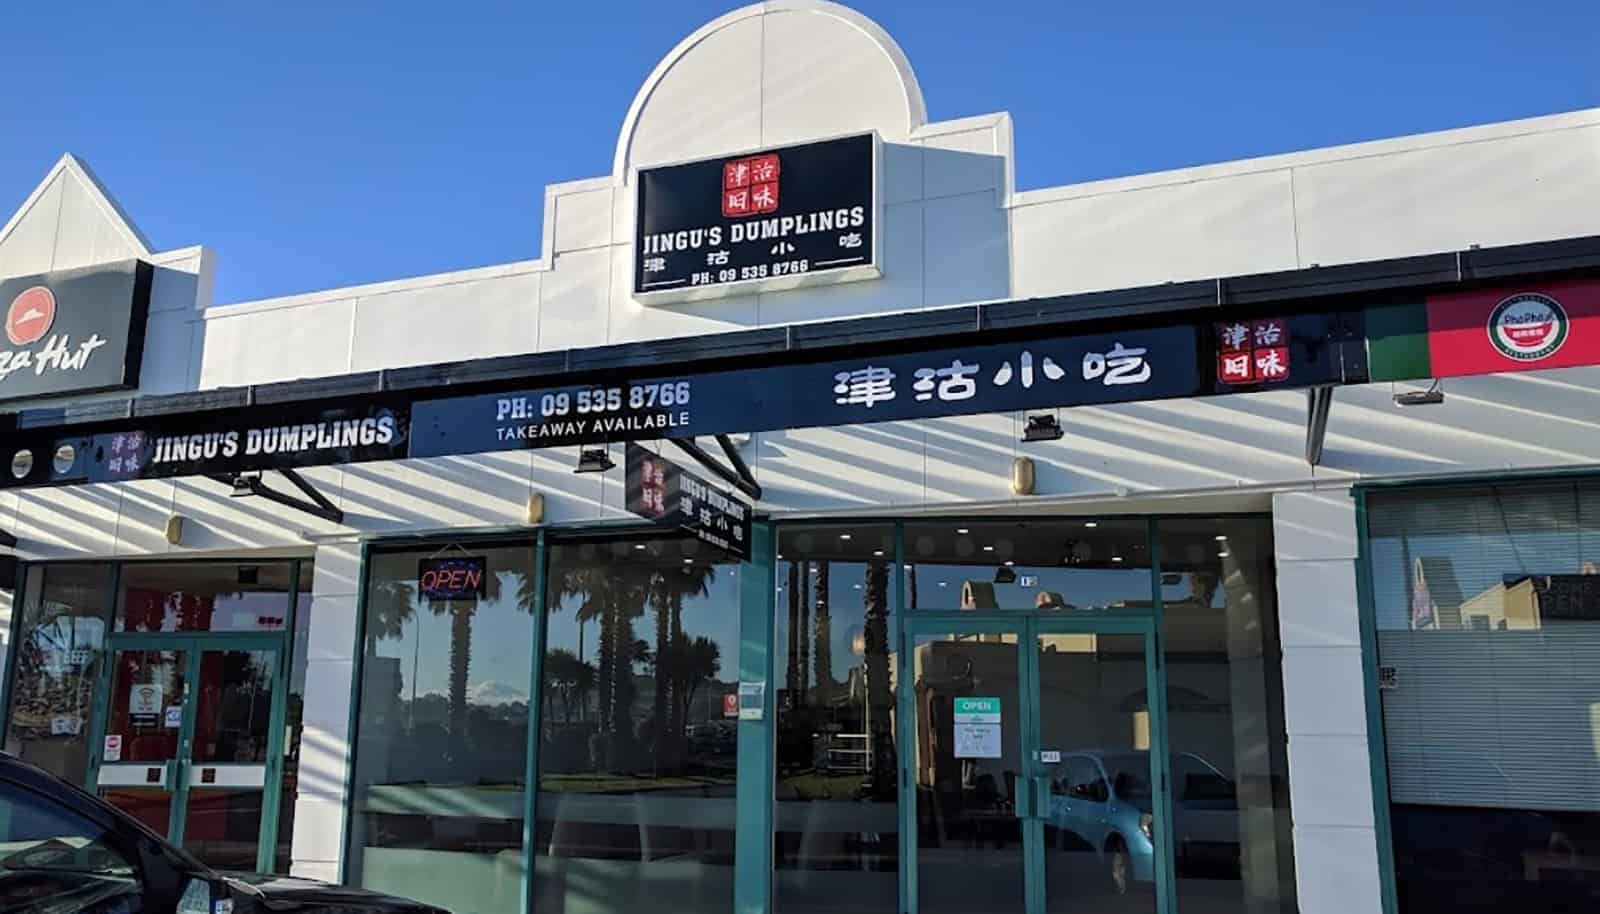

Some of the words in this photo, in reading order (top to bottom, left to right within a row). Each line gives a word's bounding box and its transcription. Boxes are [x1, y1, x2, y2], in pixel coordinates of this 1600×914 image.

[643, 227, 722, 254] JINGU'S
[731, 206, 864, 243] DUMPLINGS
[692, 273, 714, 285] PH:
[719, 269, 736, 283] 09
[741, 265, 767, 279] 535
[773, 259, 808, 273] 8766
[35, 334, 107, 375] Hut
[833, 342, 1151, 408] 津沽小吃
[496, 397, 533, 420] PH:
[541, 392, 570, 416] 09
[577, 388, 621, 413] 535
[629, 381, 690, 408] 8766
[152, 431, 238, 463] JINGU'S
[245, 416, 393, 455] DUMPLINGS
[496, 420, 586, 441] TAKEAWAY
[592, 412, 689, 433] AVAILABLE
[421, 568, 482, 592] OPEN
